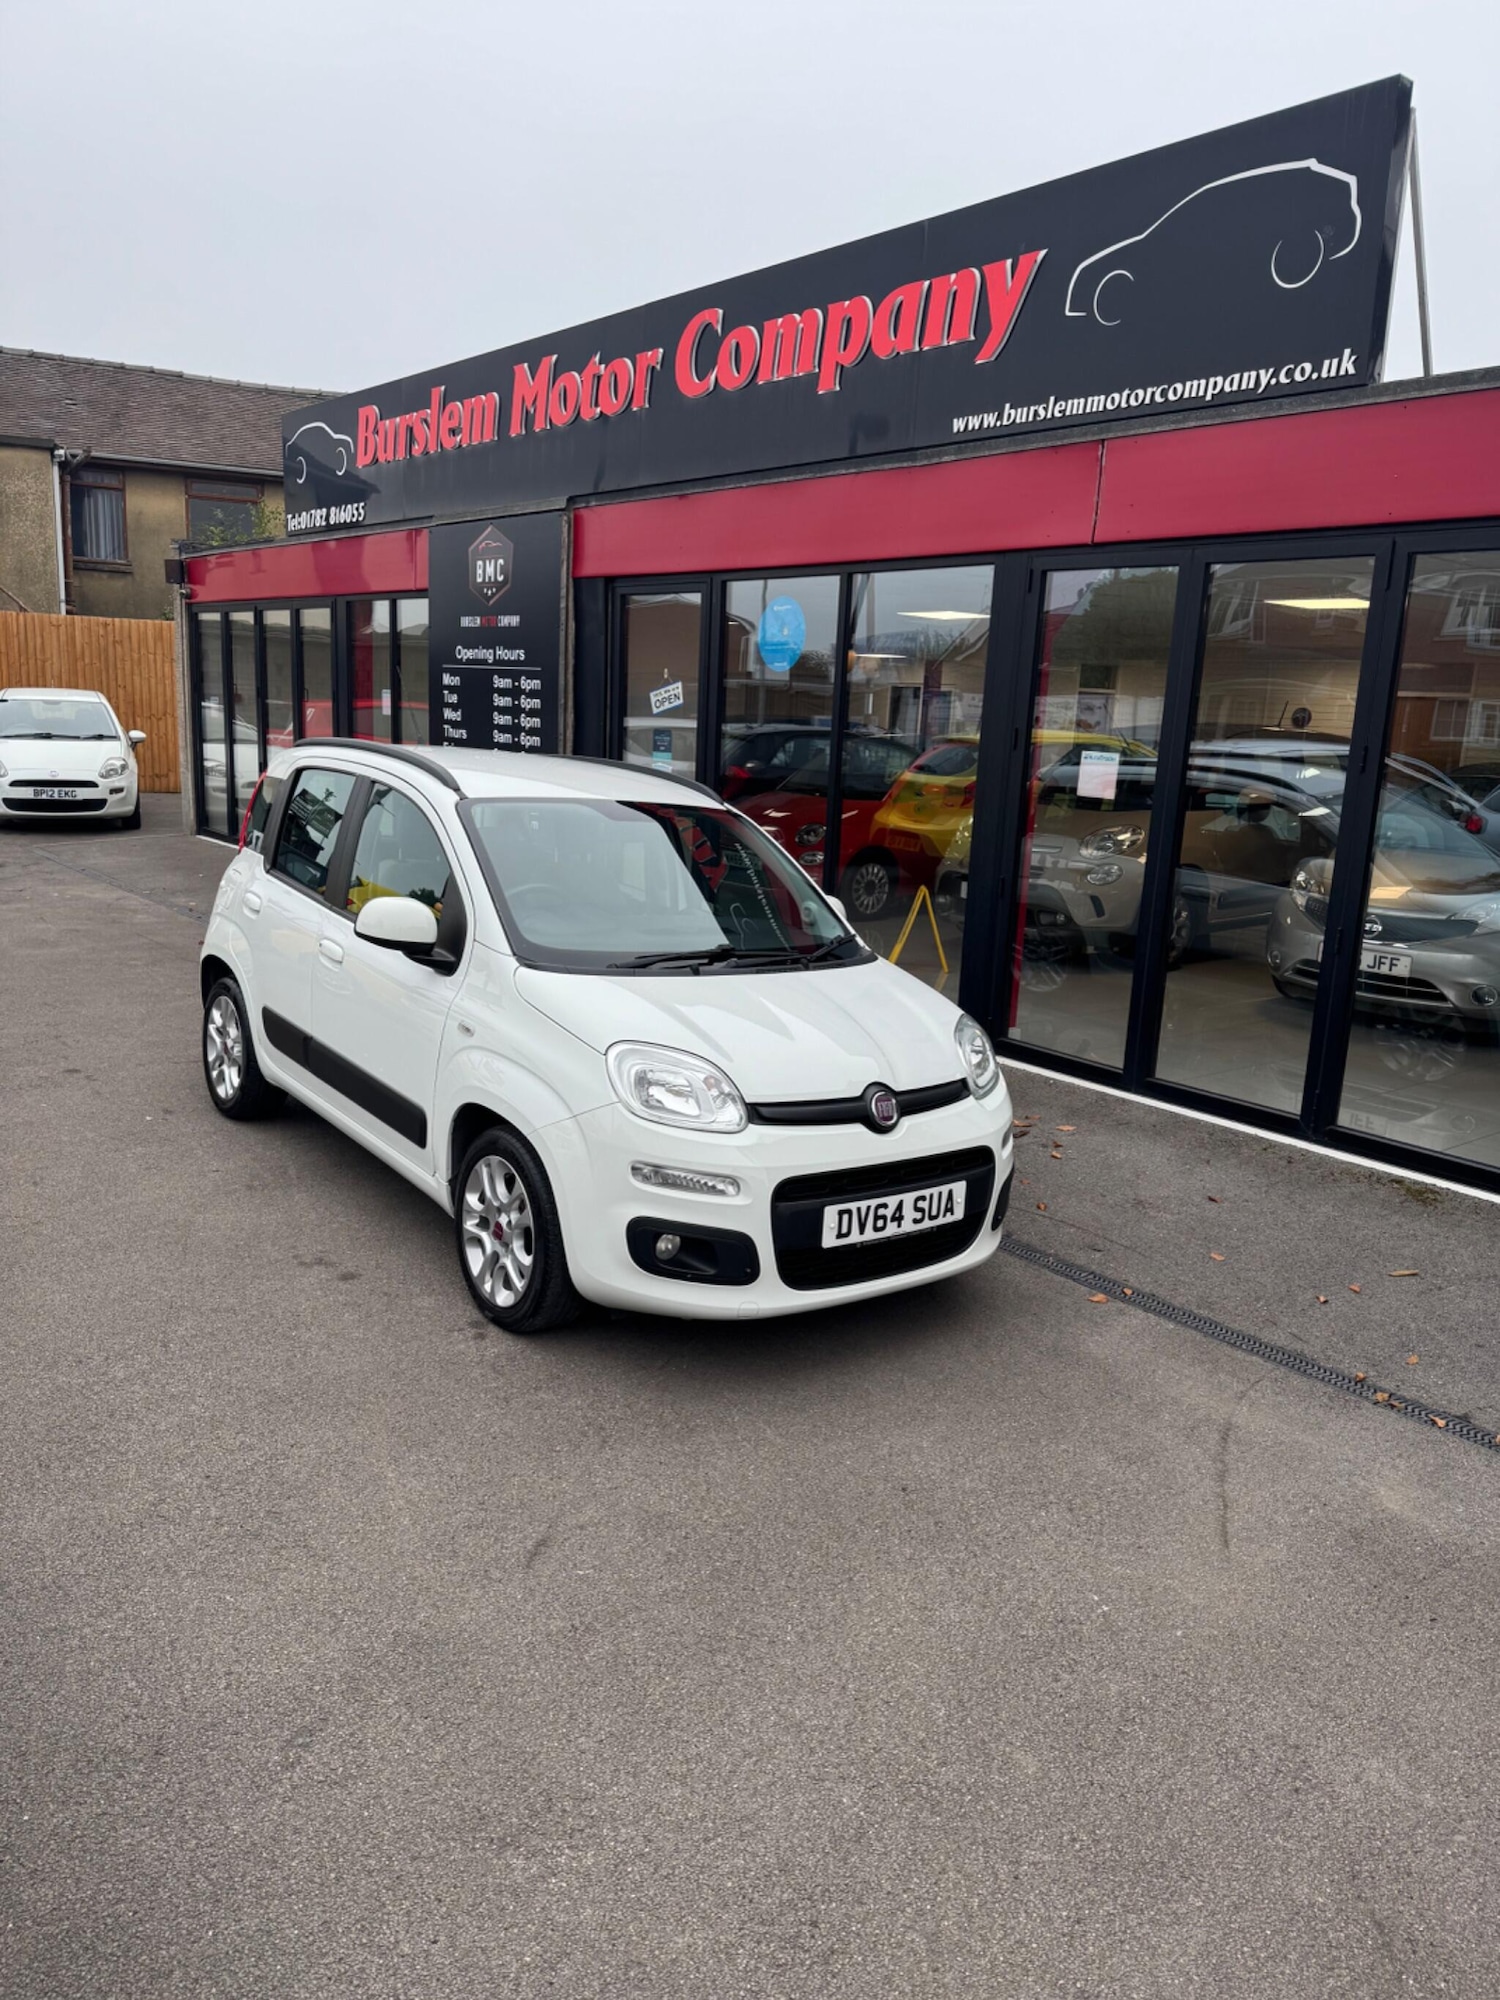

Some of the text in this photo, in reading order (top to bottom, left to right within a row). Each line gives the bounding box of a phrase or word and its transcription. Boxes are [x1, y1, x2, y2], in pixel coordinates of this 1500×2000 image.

[355, 247, 1049, 469] Burslem Motor Company
[952, 347, 1358, 435] www.burslemmotorcompany.co.uk
[329, 502, 365, 525] 816055
[476, 558, 504, 583] BMC
[455, 645, 526, 663] Opening Hours
[442, 673, 461, 687] Mon
[492, 675, 513, 690] 9am
[520, 676, 542, 692] 6pm
[443, 690, 458, 704] Tue
[492, 693, 513, 708] 9am
[520, 694, 542, 711] 6pm
[654, 692, 681, 709] OPEN
[443, 708, 462, 722] Wed
[492, 711, 513, 727] 9am
[520, 713, 542, 729] 6pm
[443, 725, 468, 740] Thurs
[492, 729, 513, 744] 9am
[520, 731, 542, 748] 6pm
[33, 788, 55, 798] BP12
[1367, 954, 1401, 972] JFF
[835, 1199, 905, 1240] DV64
[912, 1188, 955, 1225] SUA
